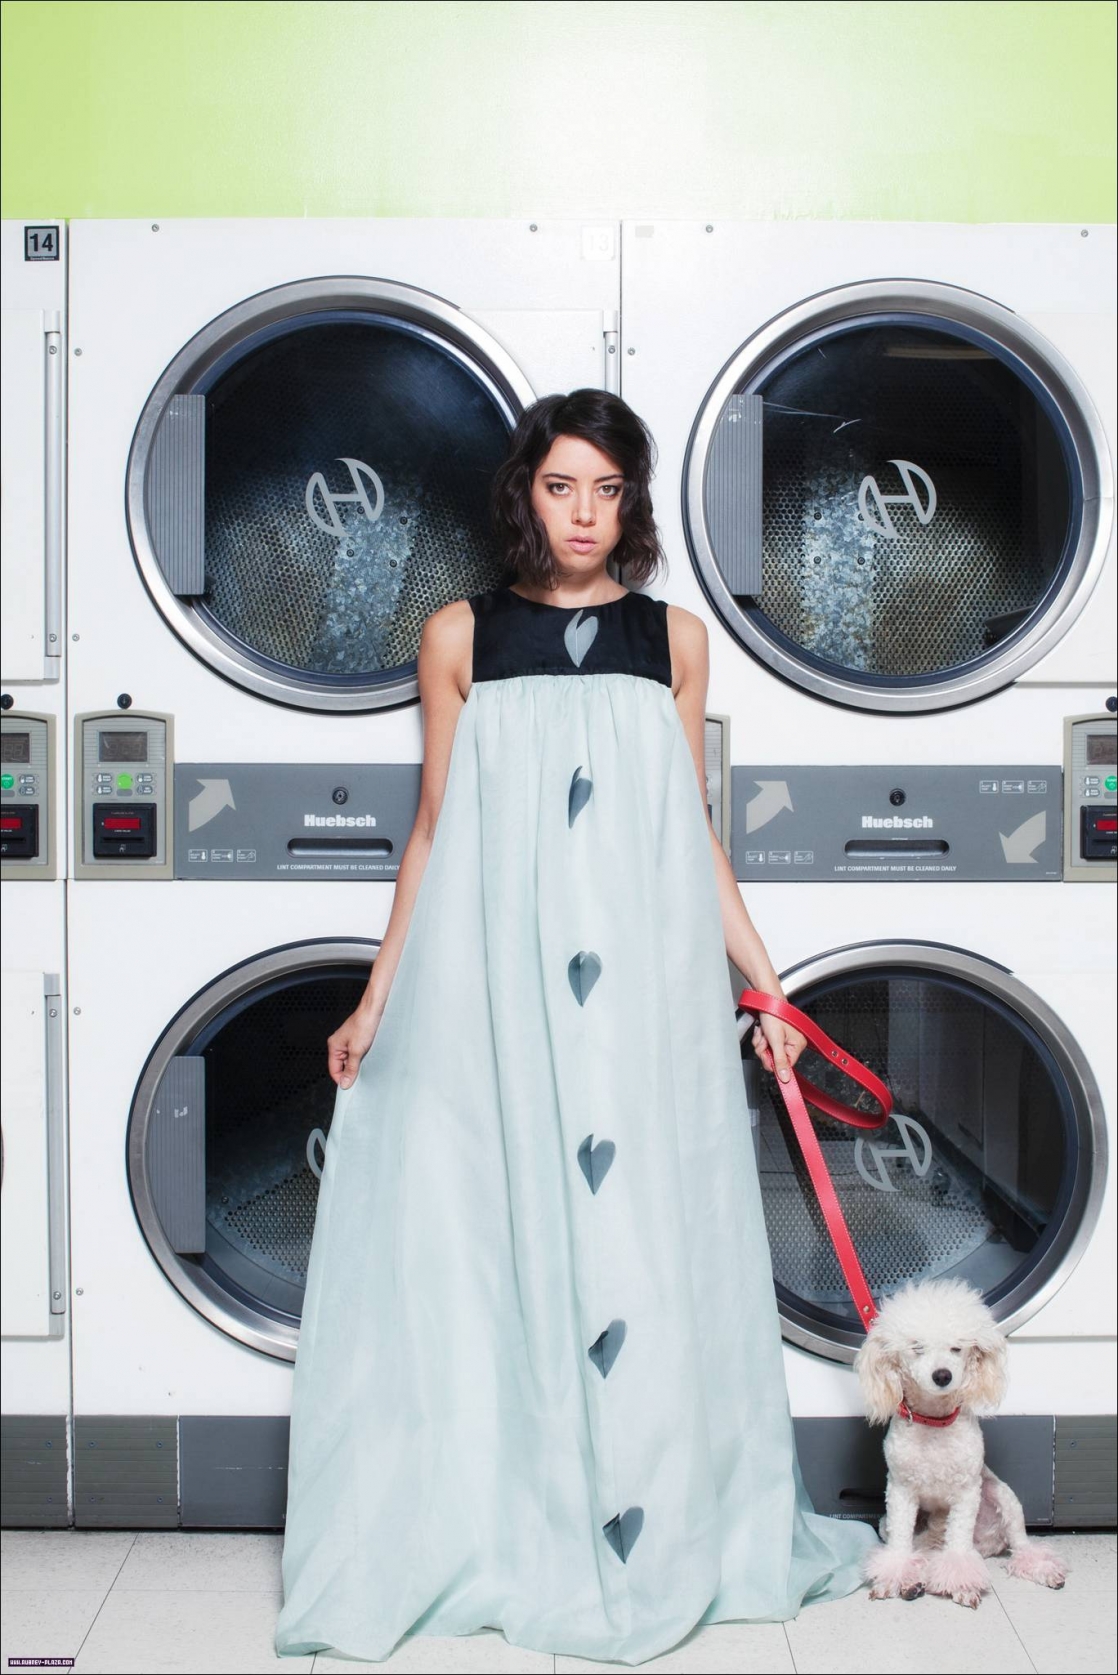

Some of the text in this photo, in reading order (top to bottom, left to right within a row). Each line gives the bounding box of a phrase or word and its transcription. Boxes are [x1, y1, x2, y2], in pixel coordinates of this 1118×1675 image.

[30, 233, 53, 252] 14
[304, 814, 377, 827] Huebsch
[861, 815, 934, 828] Huebsch
